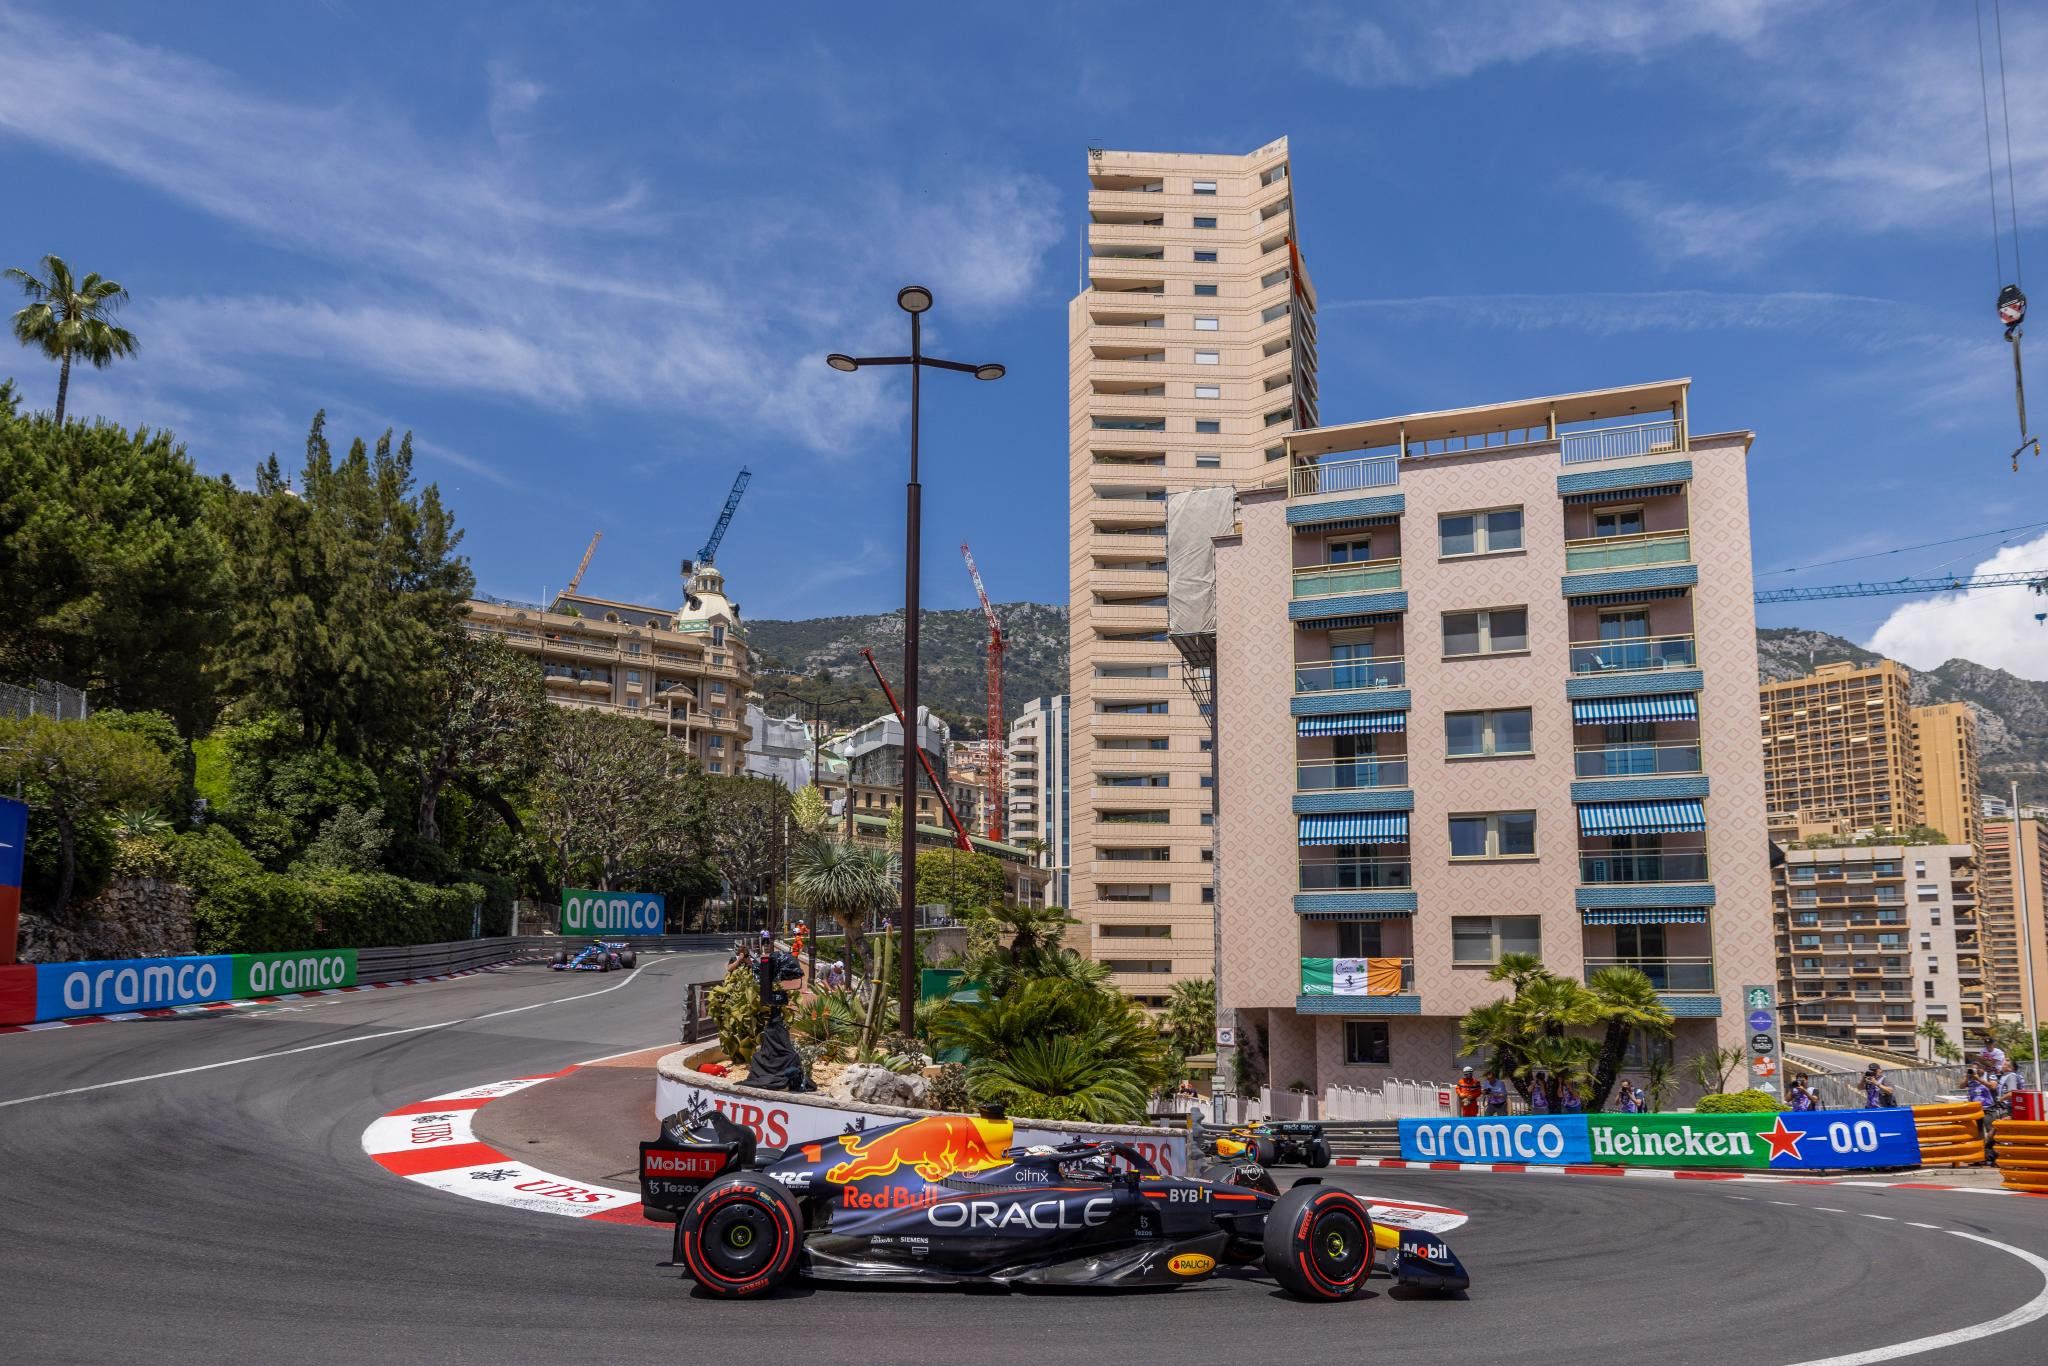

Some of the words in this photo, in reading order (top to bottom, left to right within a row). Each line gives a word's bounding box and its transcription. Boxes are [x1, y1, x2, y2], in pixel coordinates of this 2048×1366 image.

[566, 896, 660, 929] aramco
[249, 955, 345, 992] aramco
[64, 963, 217, 1011] aramco
[1416, 1123, 1564, 1159] aramco
[1591, 1125, 1754, 1157] Heineken
[1828, 1120, 1879, 1154] 0.0
[646, 1156, 695, 1171] Mobil
[801, 1144, 822, 1163] 1
[1015, 1167, 1049, 1182] citrix
[514, 1179, 615, 1204] UBS
[663, 1182, 699, 1193] Tezos
[709, 1186, 758, 1204] ZERO
[843, 1185, 889, 1208] Red
[893, 1186, 938, 1208] Bull
[1169, 1186, 1213, 1203] BYBIT
[928, 1198, 1113, 1229] ORACLE
[900, 1236, 929, 1244] SIEMENS
[1403, 1243, 1448, 1259] Mobil
[1180, 1260, 1210, 1269] RAUCH
